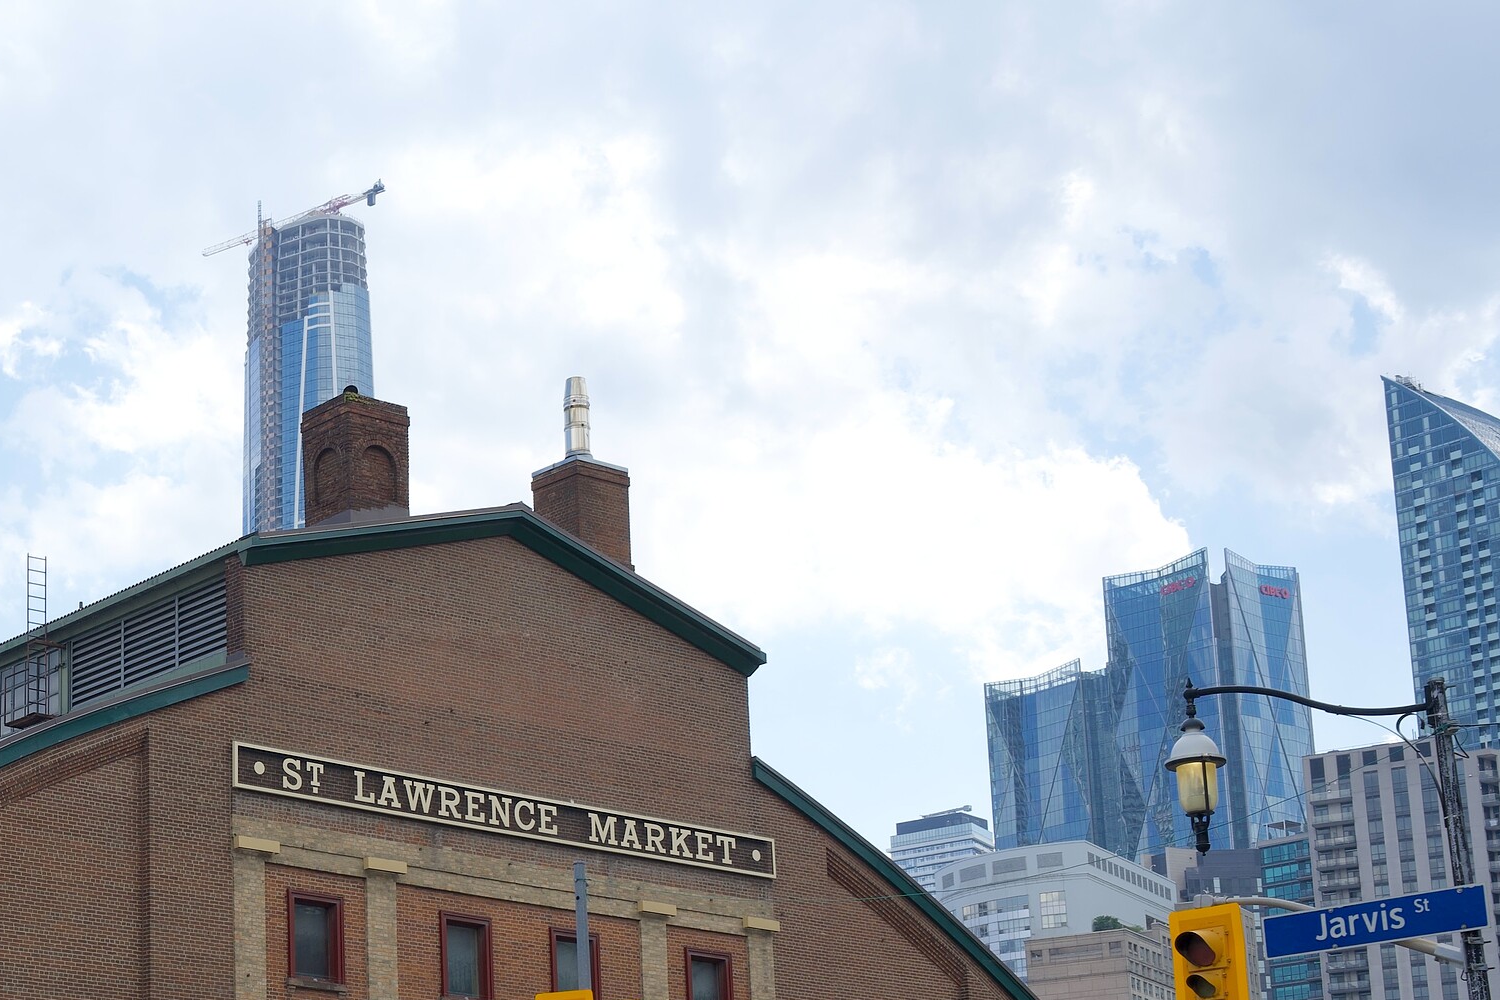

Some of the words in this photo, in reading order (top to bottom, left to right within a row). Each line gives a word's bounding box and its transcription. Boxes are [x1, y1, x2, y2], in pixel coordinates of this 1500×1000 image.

[281, 757, 324, 794] ST
[353, 769, 559, 836] LAWRENCE
[588, 812, 737, 865] MARKET
[1315, 903, 1406, 942] Jarvis
[1413, 898, 1431, 914] St
